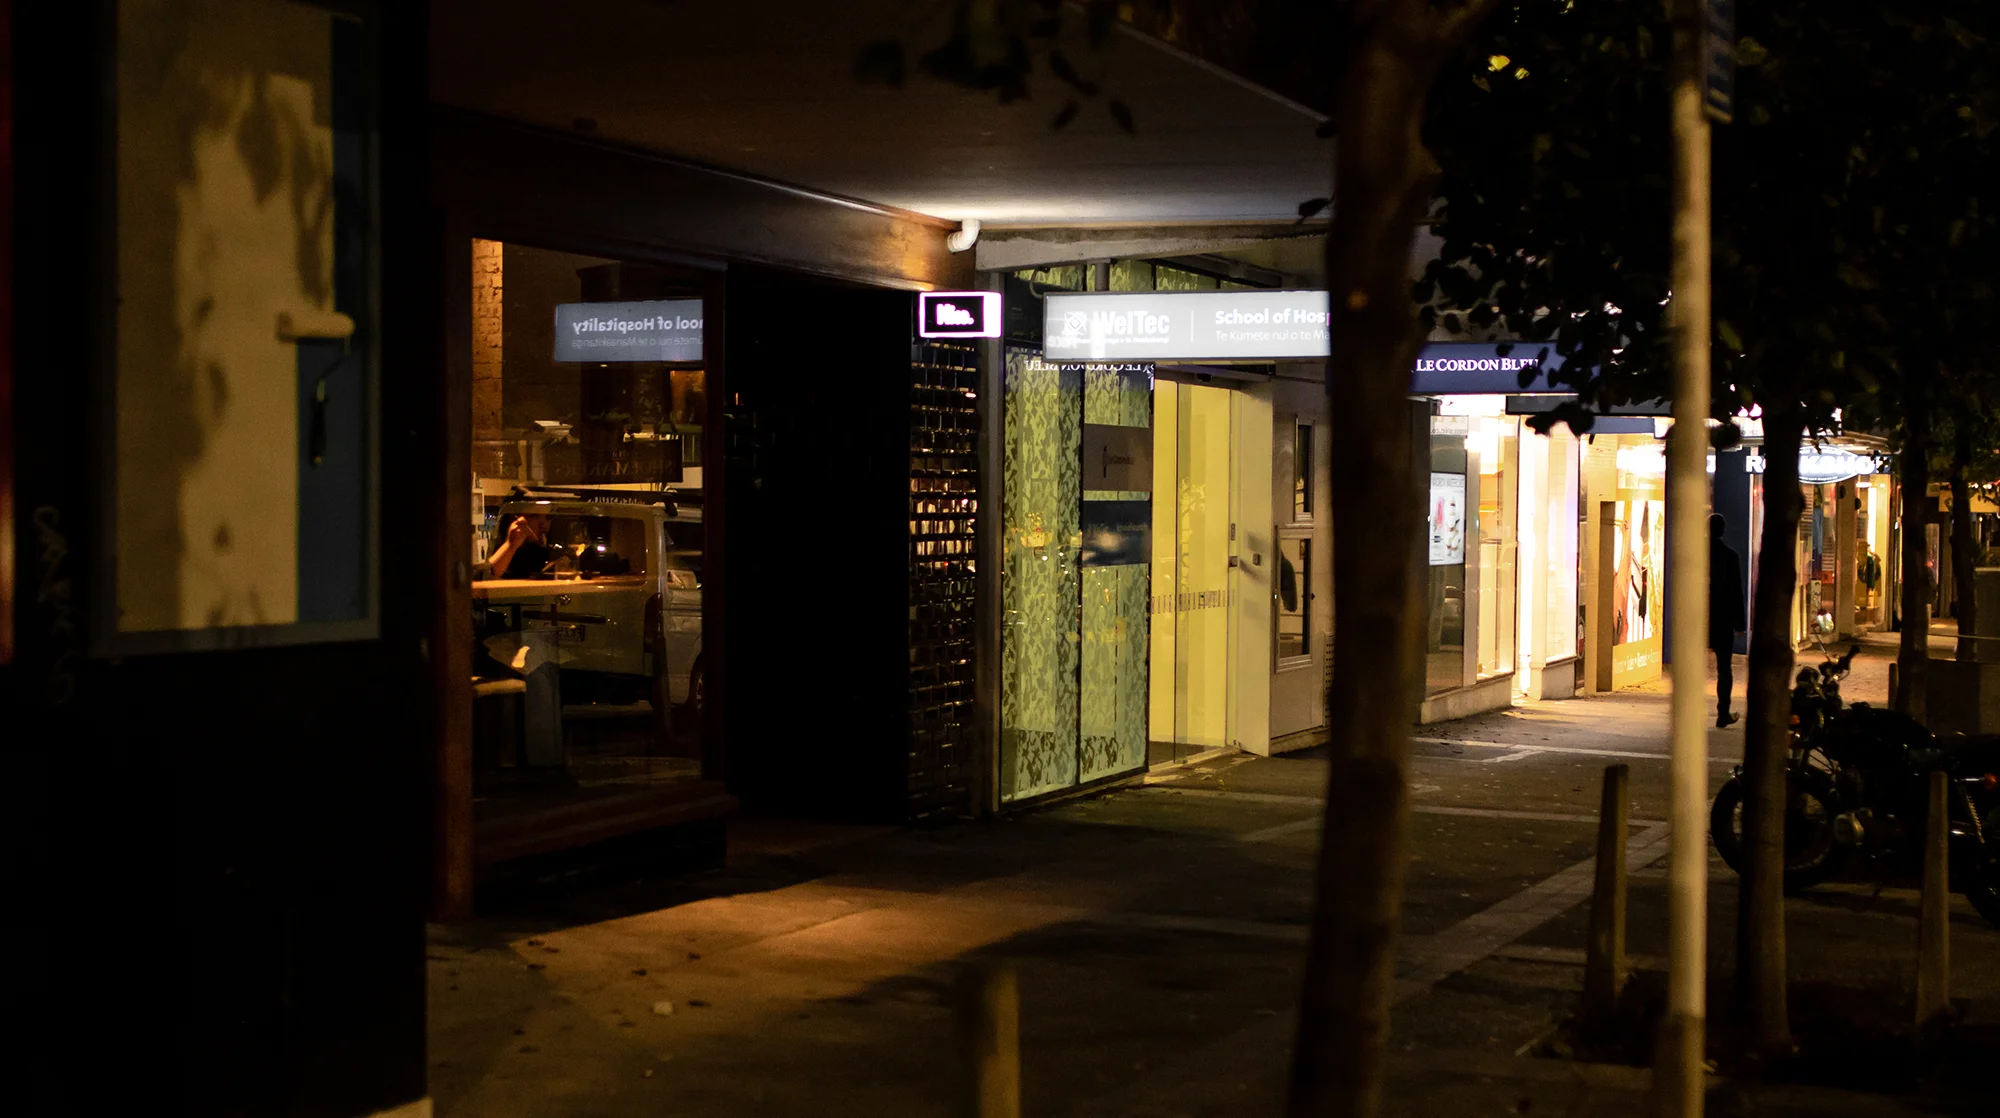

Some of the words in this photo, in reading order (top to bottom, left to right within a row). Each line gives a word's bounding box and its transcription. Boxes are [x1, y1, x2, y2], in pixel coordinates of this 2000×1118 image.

[1093, 310, 1170, 335] WelTec
[1215, 308, 1270, 325] School
[1272, 307, 1291, 325] of
[1293, 309, 1330, 326] Hos
[1215, 330, 1228, 341] Te
[1272, 330, 1290, 341] nui
[1290, 331, 1299, 341] o
[1300, 330, 1311, 341] te
[1416, 358, 1435, 371] LE
[1435, 358, 1499, 372] CORDON
